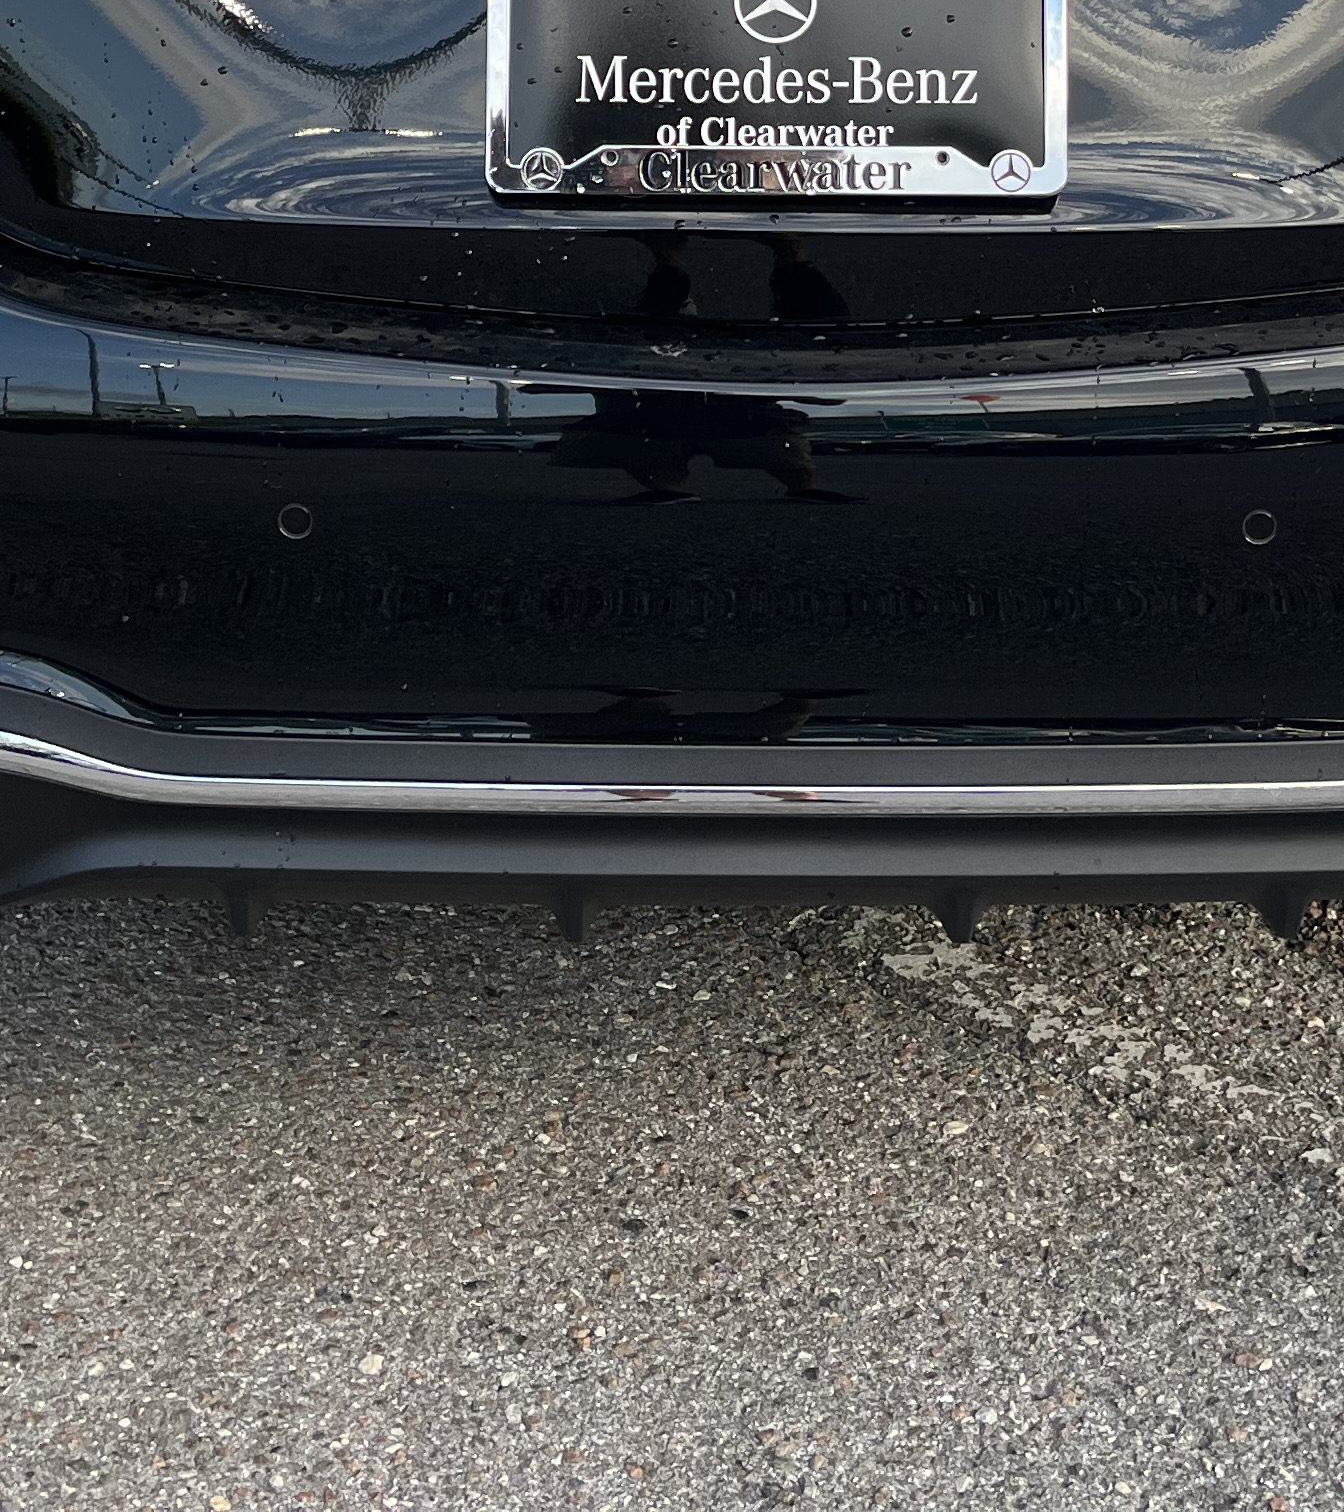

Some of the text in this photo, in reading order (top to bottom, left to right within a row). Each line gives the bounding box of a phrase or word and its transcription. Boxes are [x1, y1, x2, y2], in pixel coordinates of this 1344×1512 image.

[576, 55, 978, 105] Mercedes-Benz
[656, 116, 895, 147] of Clearwater
[638, 149, 912, 193] Clearwater
